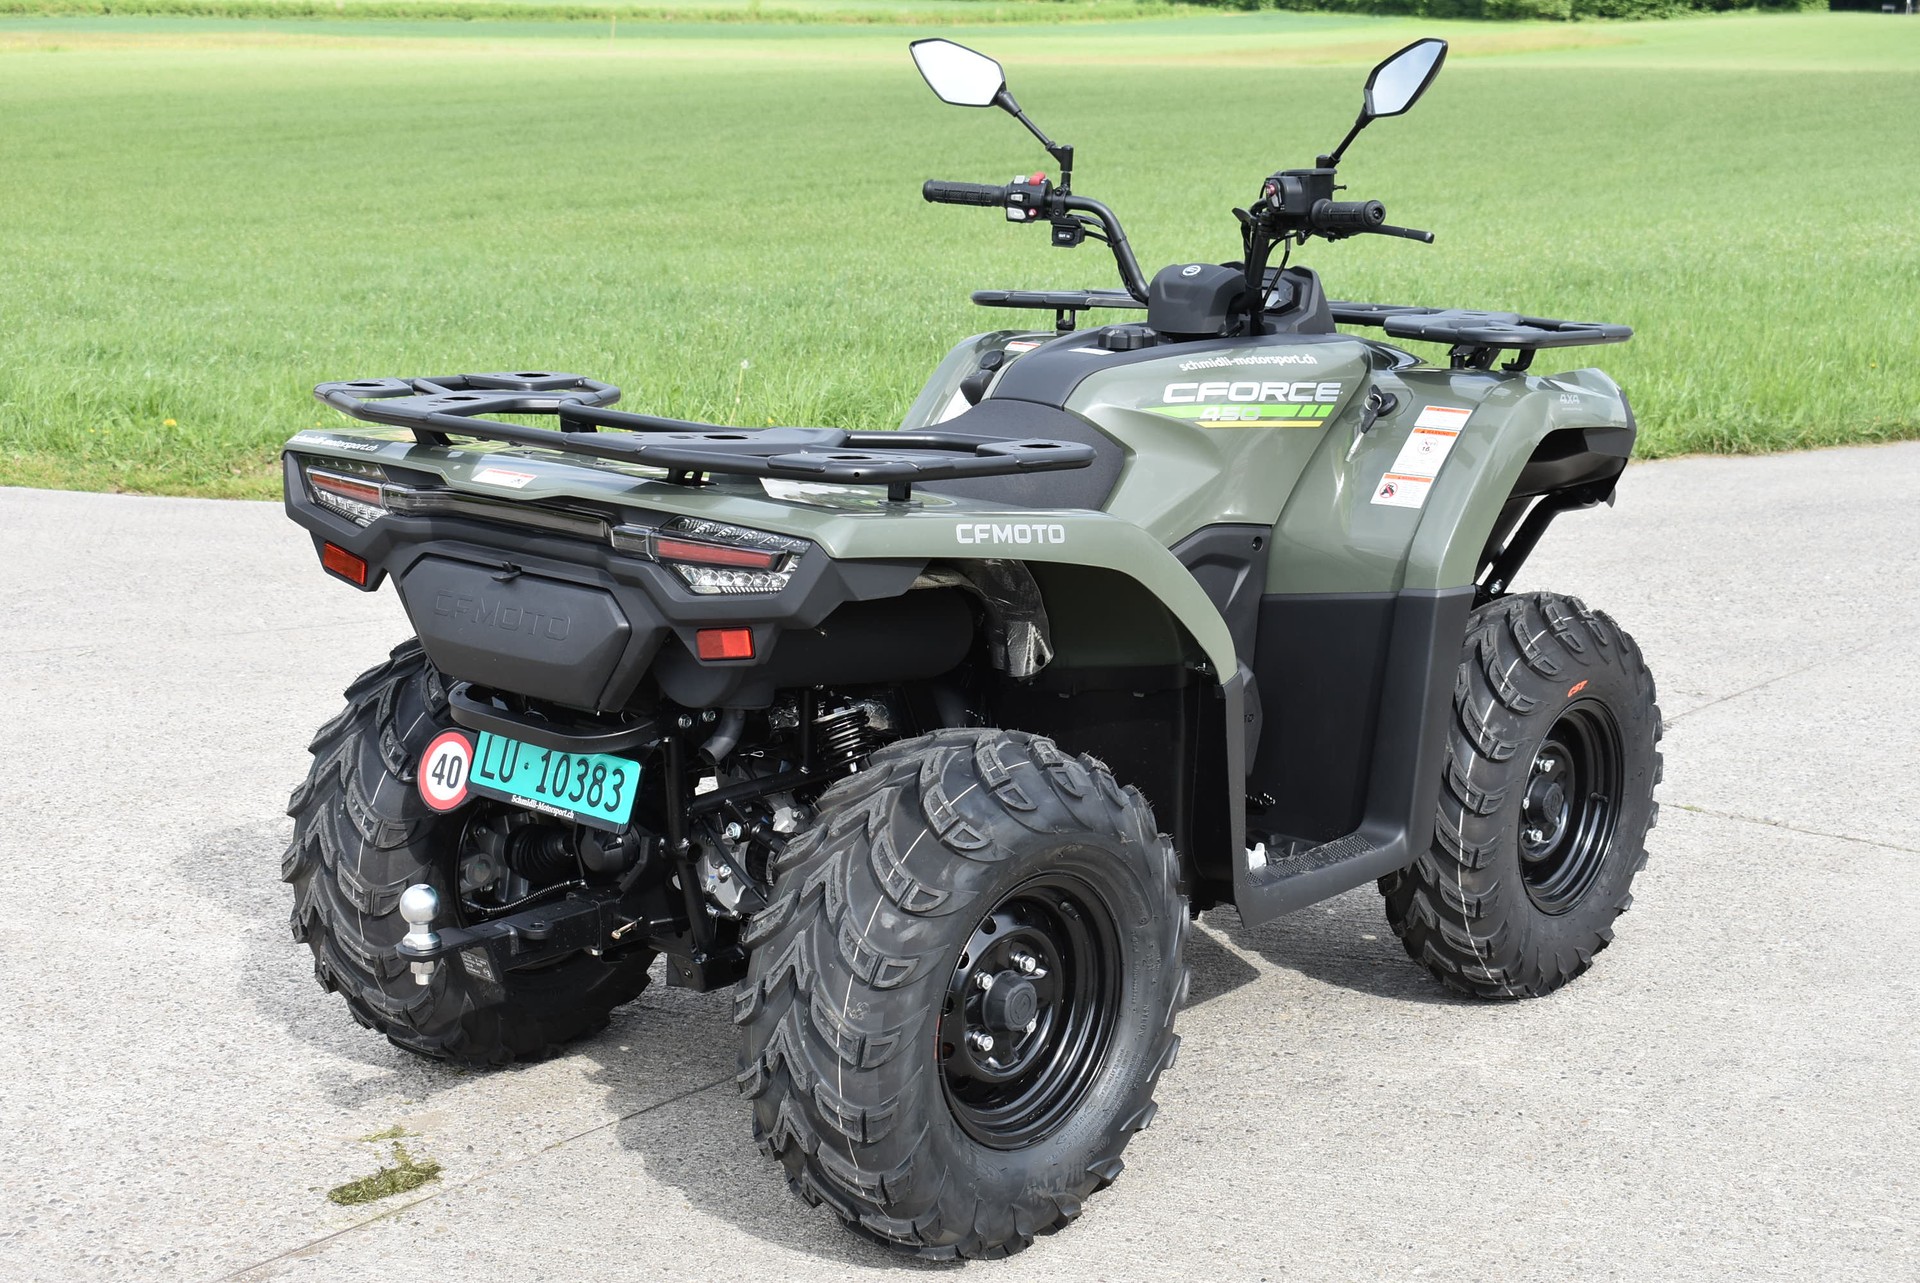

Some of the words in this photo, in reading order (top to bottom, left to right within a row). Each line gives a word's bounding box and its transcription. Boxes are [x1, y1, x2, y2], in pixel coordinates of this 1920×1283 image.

[1179, 353, 1318, 372] schmidli-motorsport.ch
[1162, 382, 1342, 403] CFORCE
[1199, 406, 1261, 421] 450
[955, 523, 1066, 545] CFMOTO
[432, 590, 572, 641] CFMOTO
[432, 753, 463, 789] 40
[535, 750, 625, 812] 10383
